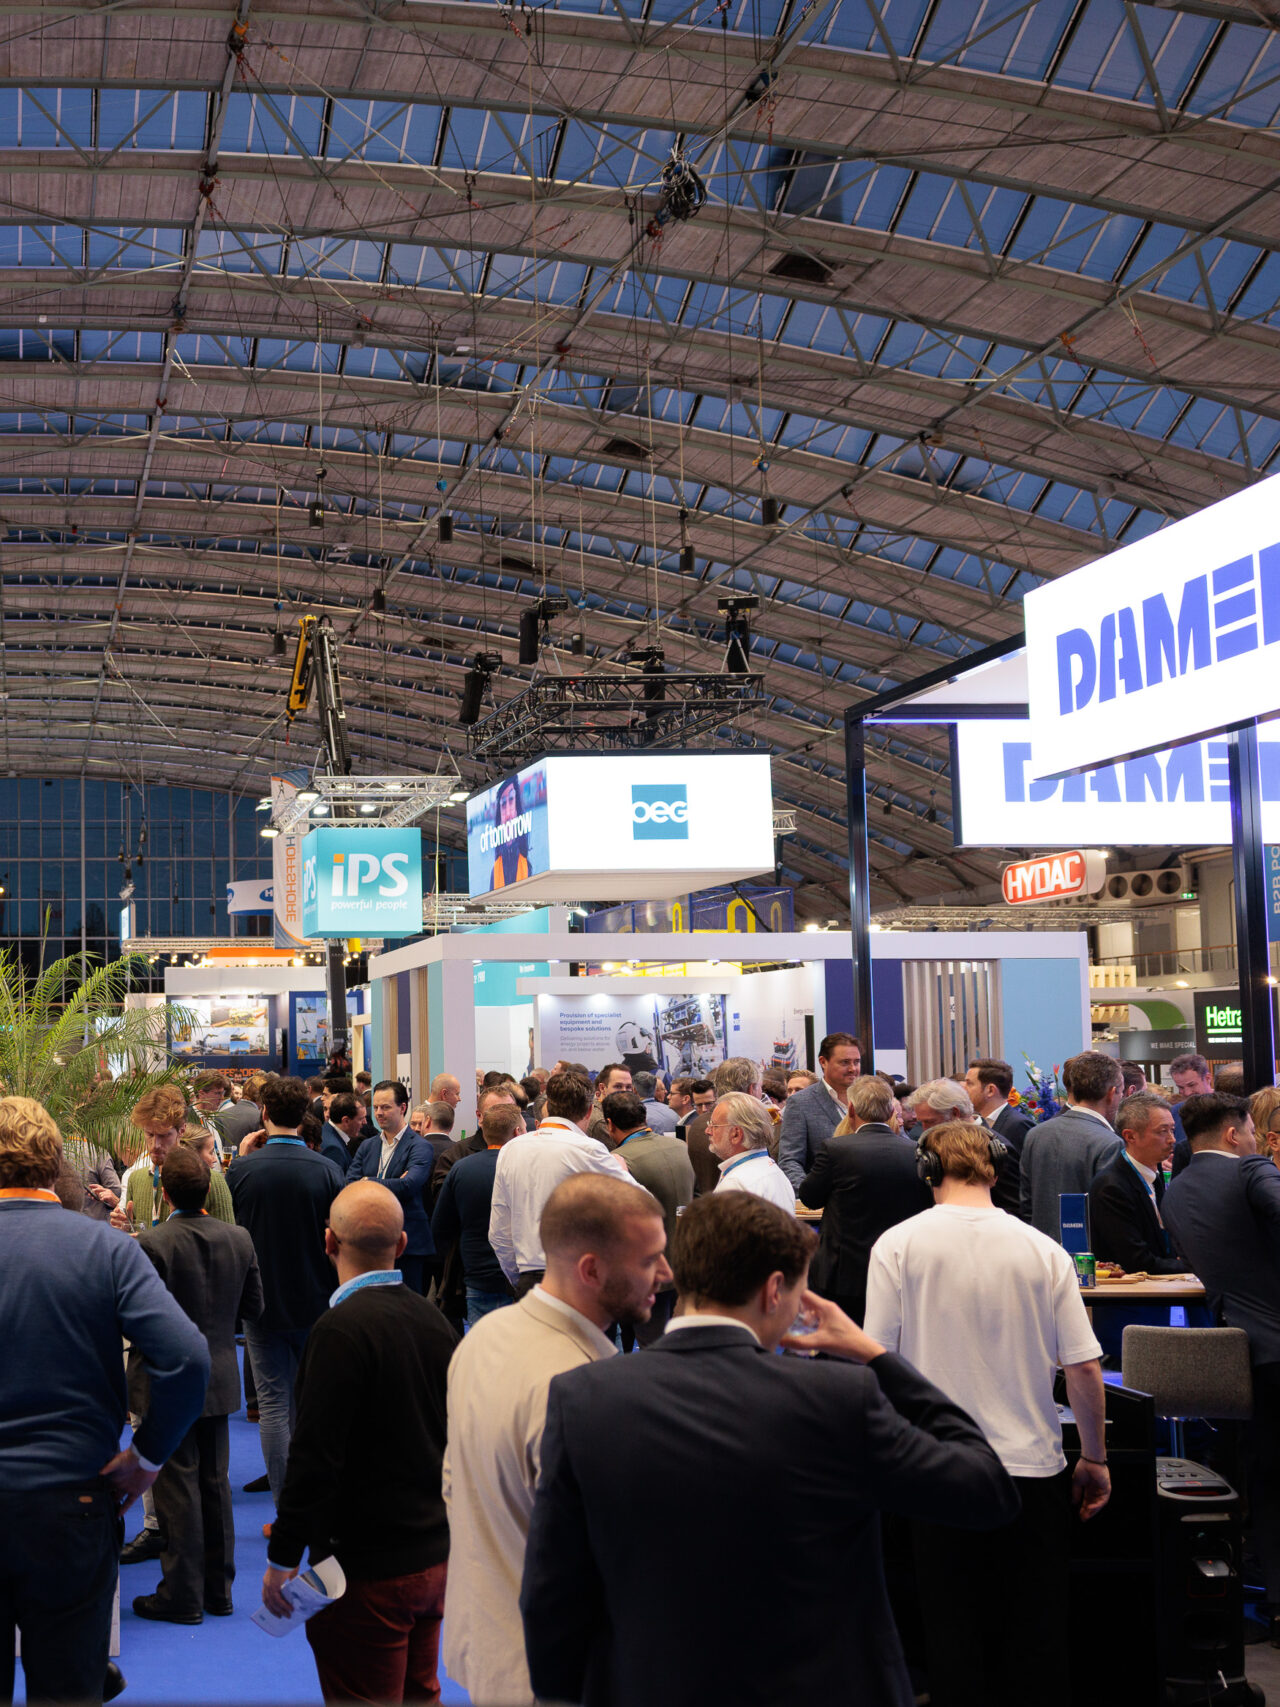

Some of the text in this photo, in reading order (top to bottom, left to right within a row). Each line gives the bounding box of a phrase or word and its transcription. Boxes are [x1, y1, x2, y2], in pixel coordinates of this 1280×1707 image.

[480, 810, 532, 853] of tomorrow
[332, 853, 408, 897] iPS
[1007, 855, 1081, 900] HYDAC
[331, 899, 408, 911] powerful people
